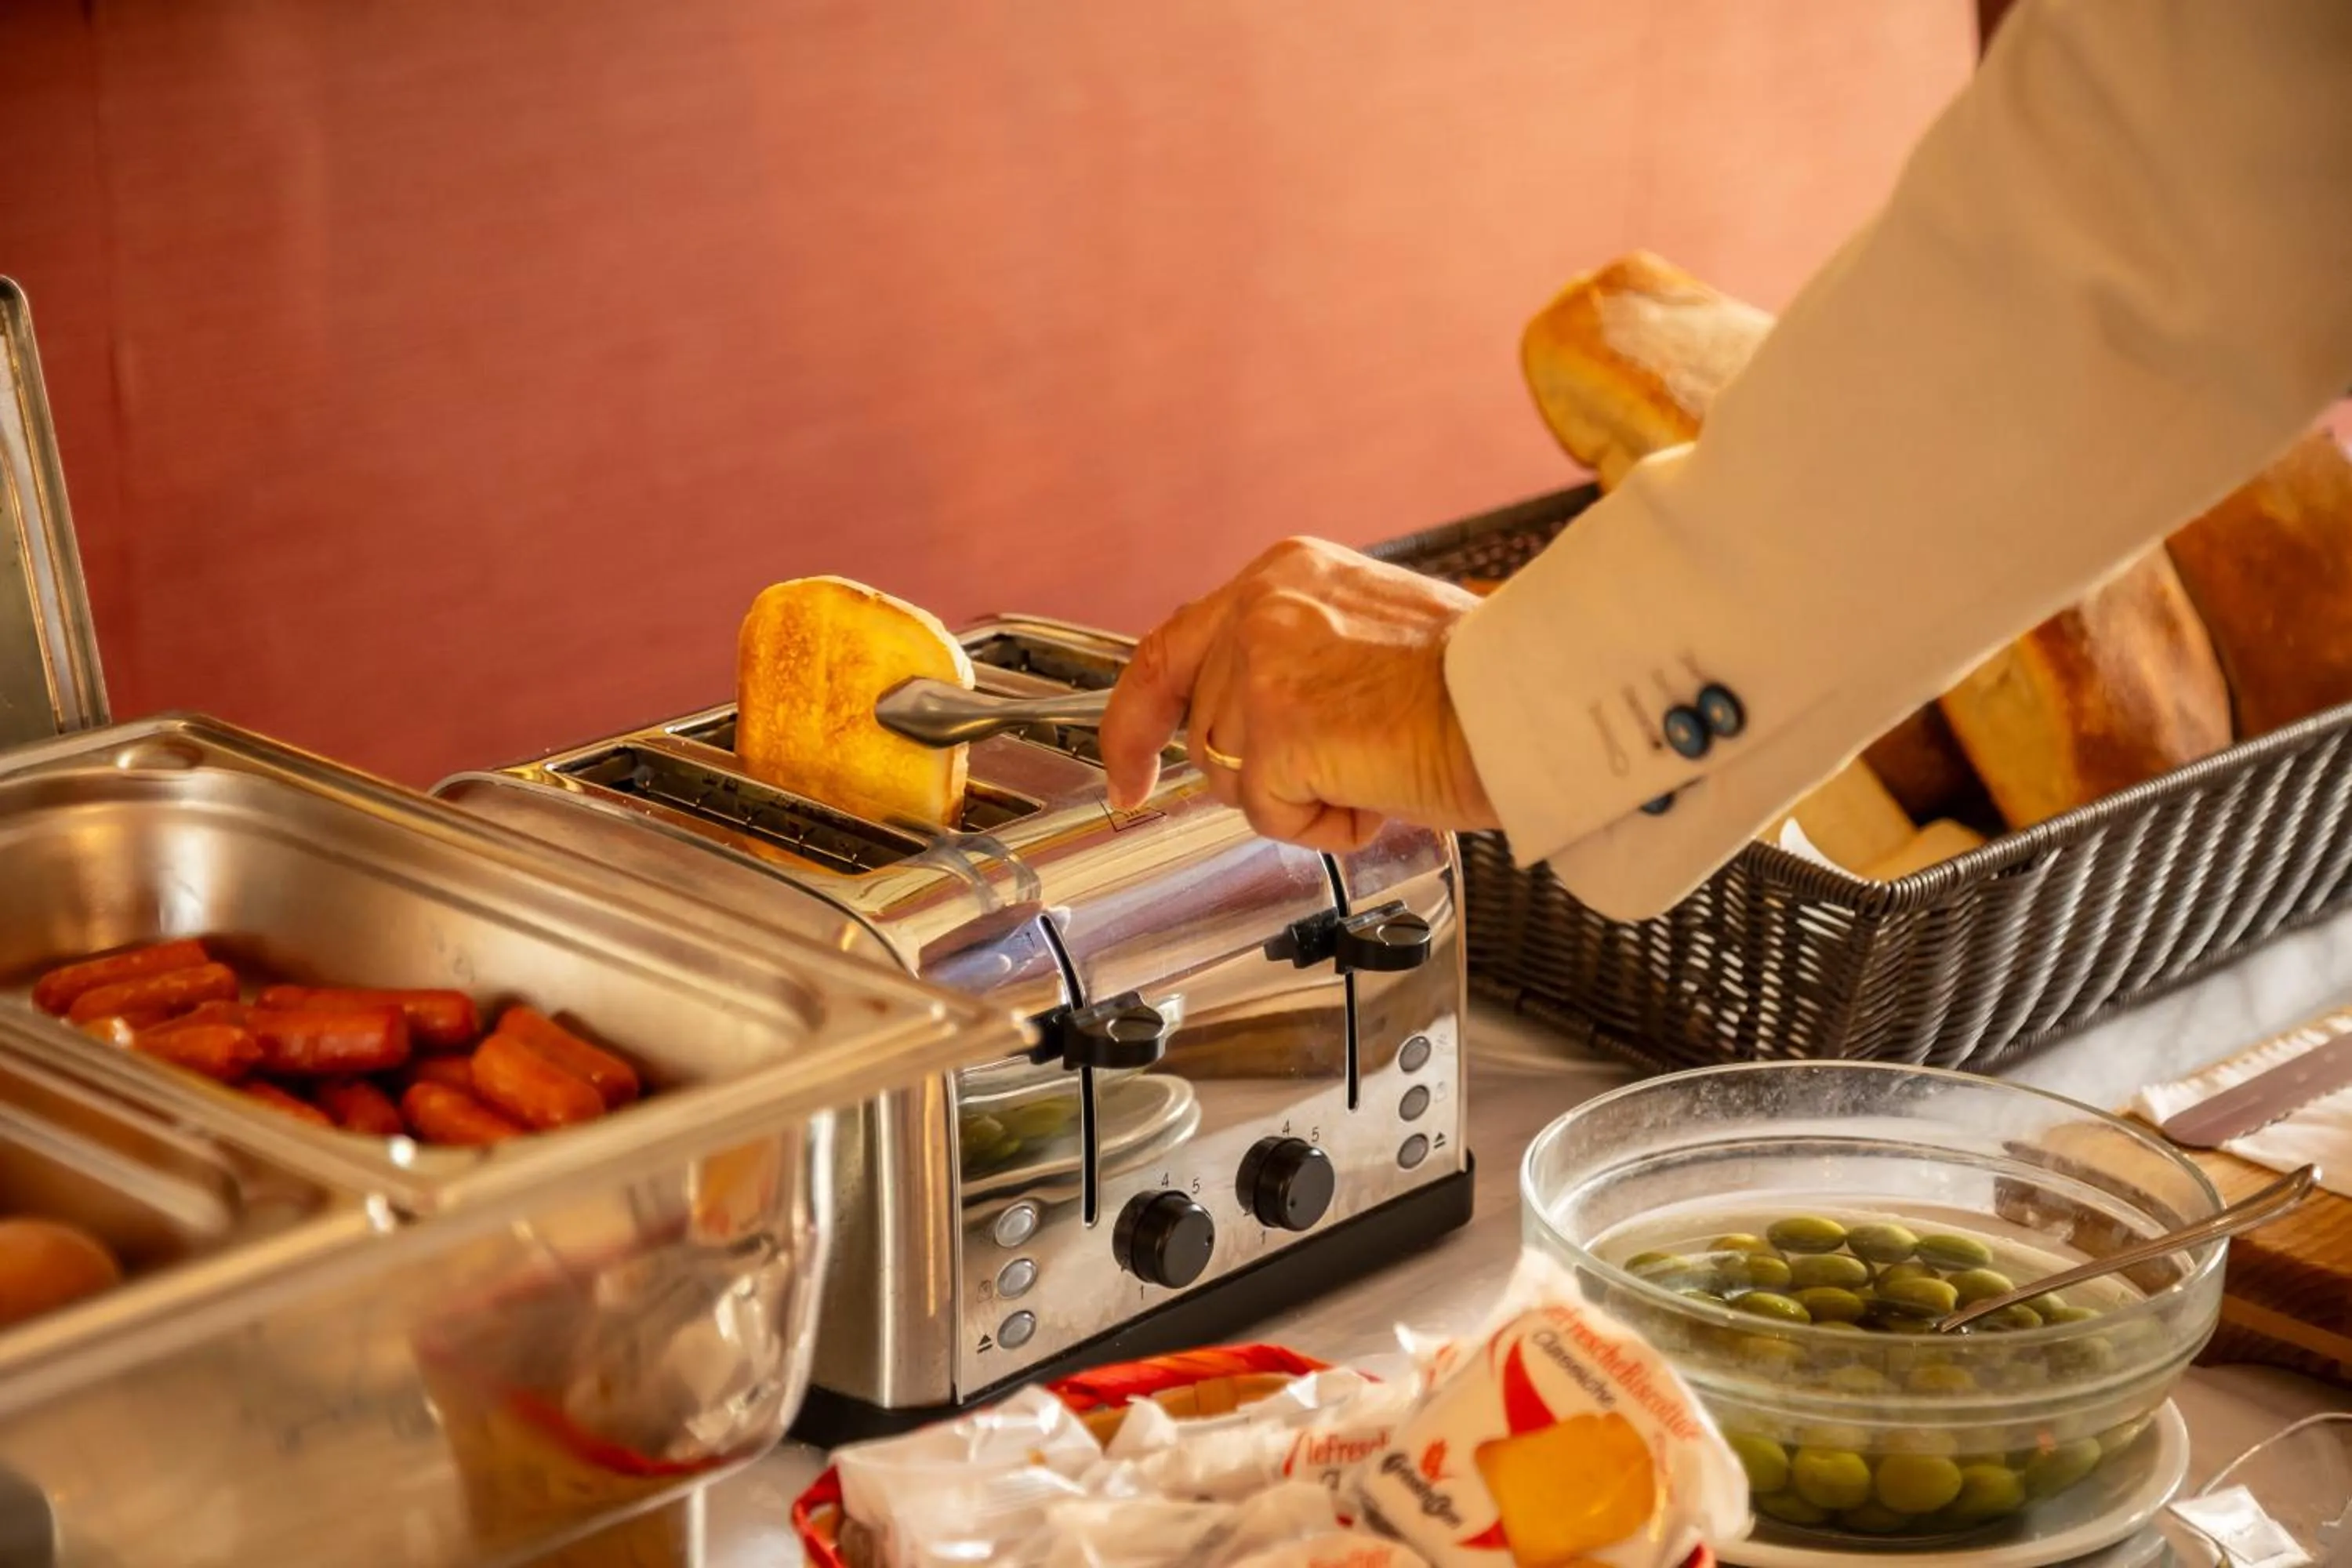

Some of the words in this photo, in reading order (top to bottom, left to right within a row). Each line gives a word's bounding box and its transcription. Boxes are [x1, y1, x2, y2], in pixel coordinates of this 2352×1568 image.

[1281, 1120, 1291, 1135] 4
[1311, 1126, 1321, 1142] 5
[1160, 1172, 1170, 1188] 4
[1191, 1177, 1201, 1194] 5
[1260, 1230, 1267, 1245] 1
